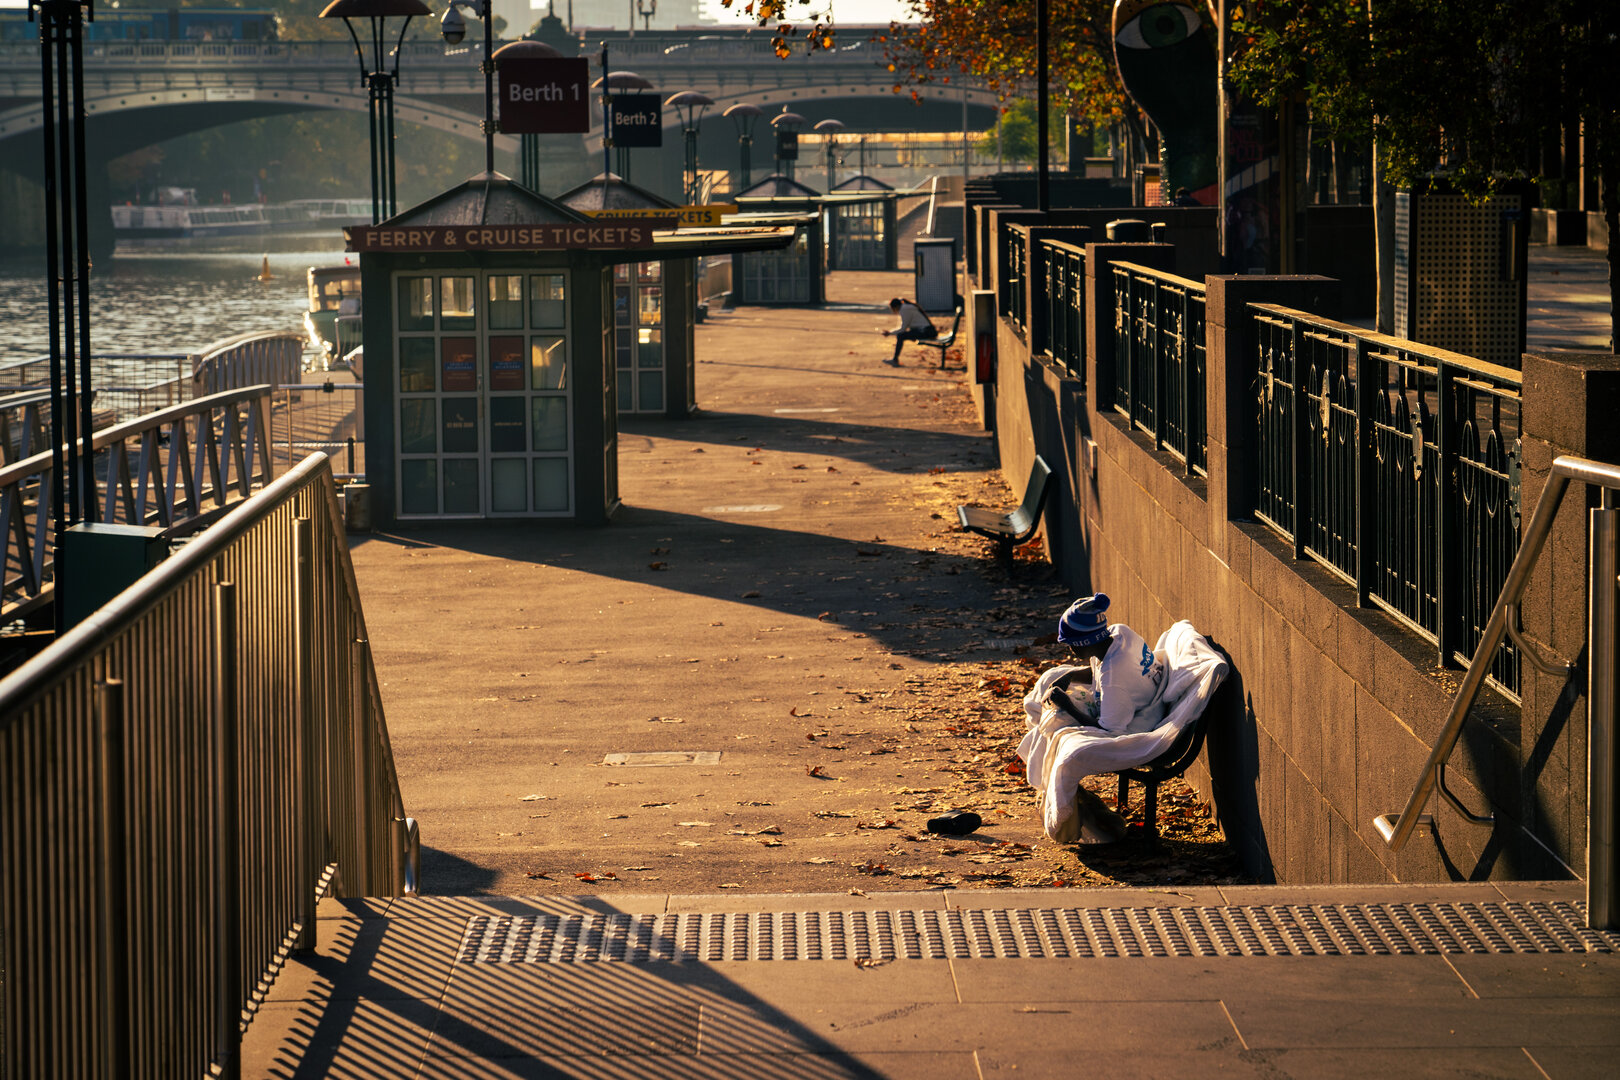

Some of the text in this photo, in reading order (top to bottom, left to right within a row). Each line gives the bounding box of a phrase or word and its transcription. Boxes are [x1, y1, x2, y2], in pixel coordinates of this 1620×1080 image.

[509, 82, 580, 102] Berth 1
[615, 111, 657, 126] Berth 2
[366, 226, 642, 247] FERRY & CRUISE TICKETS
